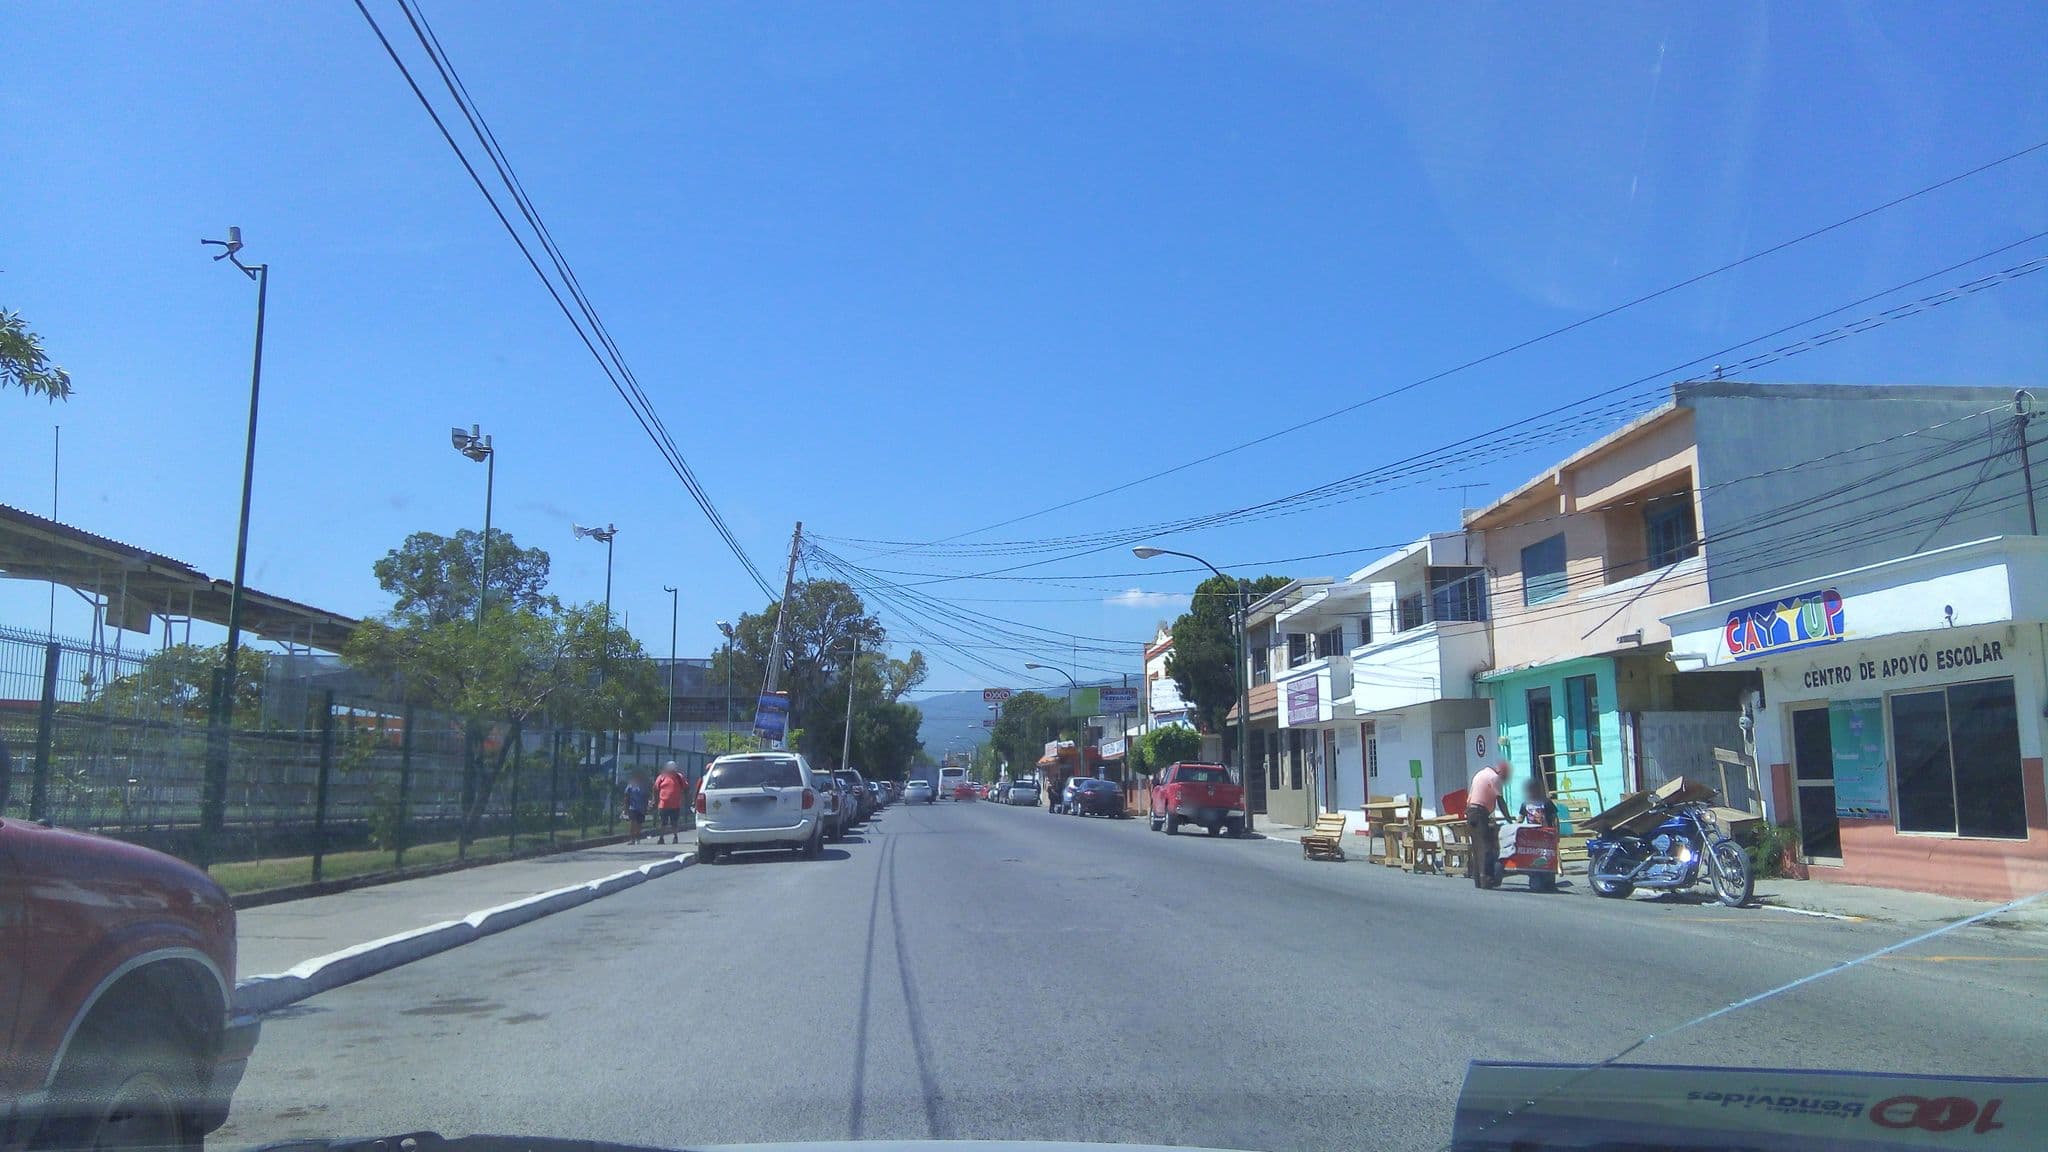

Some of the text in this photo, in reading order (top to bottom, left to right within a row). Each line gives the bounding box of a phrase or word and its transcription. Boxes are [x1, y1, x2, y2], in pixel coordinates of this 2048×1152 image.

[1726, 588, 1844, 655] CAYYUP
[1804, 640, 2004, 689] CENTRO DE APOYO ESCOLAR
[984, 690, 1011, 700] OXXO
[1687, 1090, 1865, 1118] benavides
